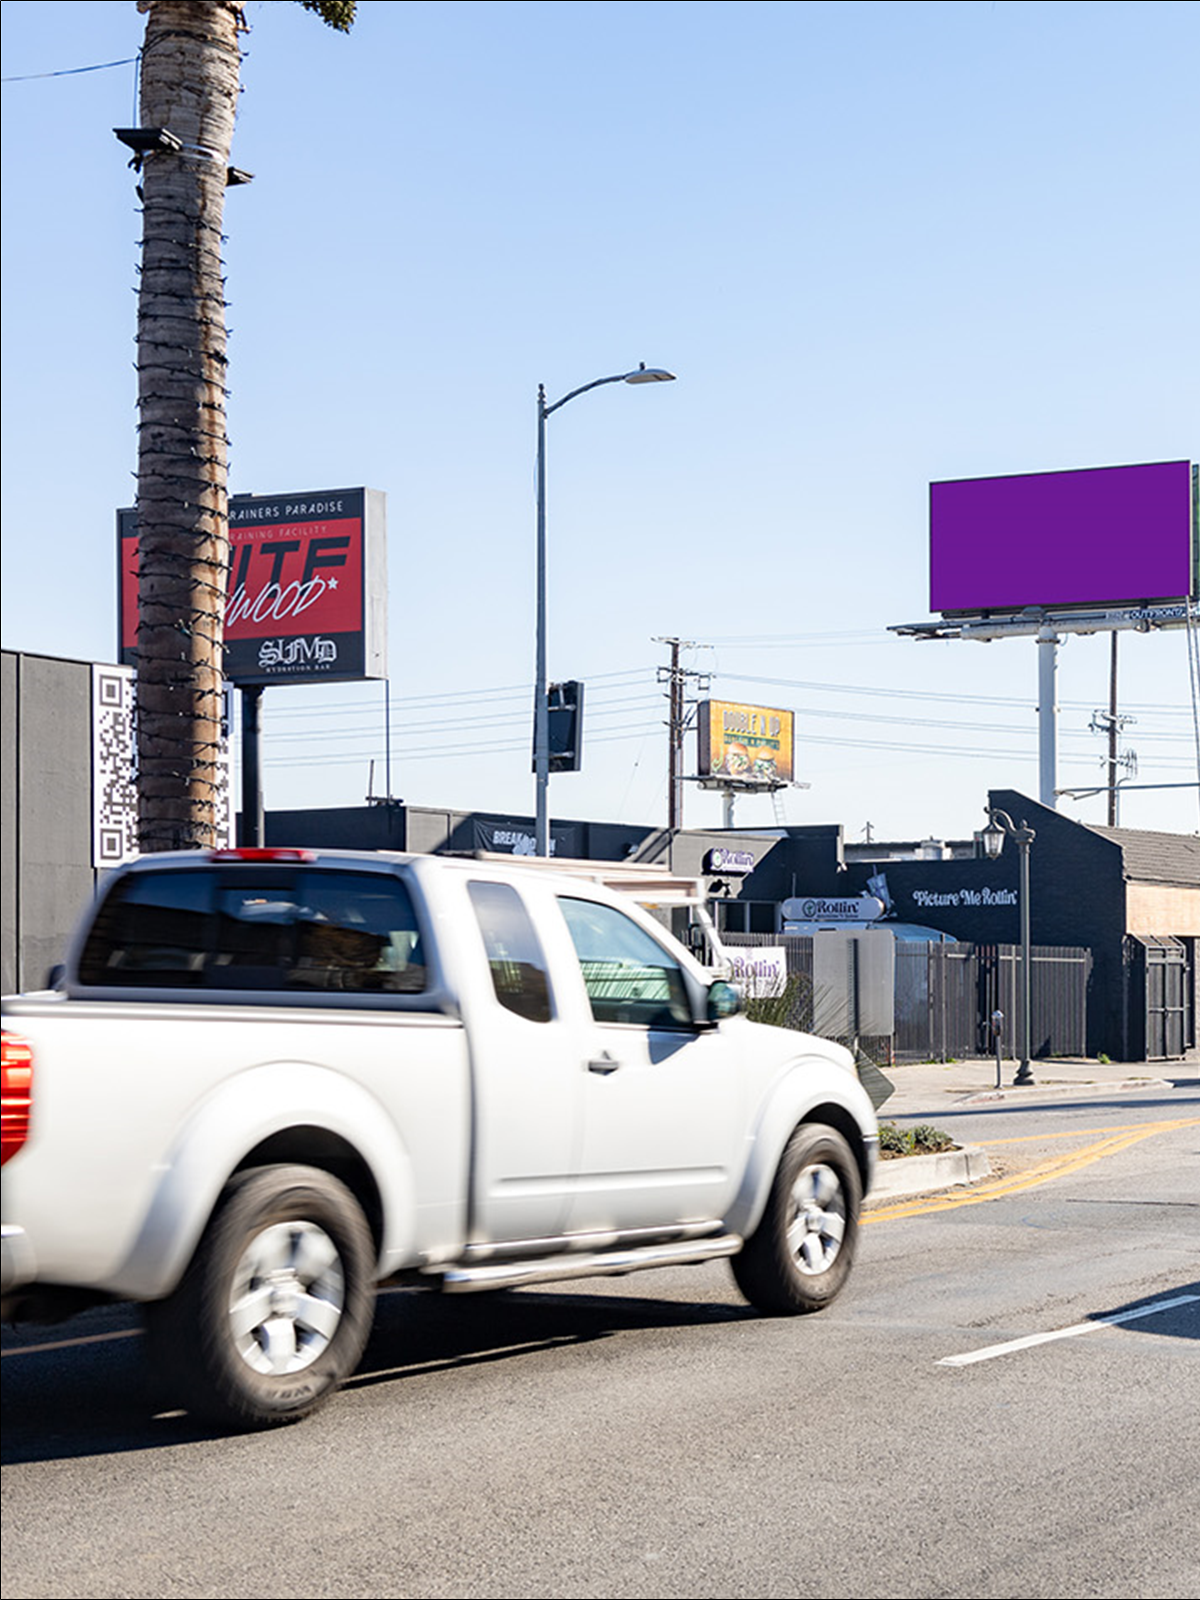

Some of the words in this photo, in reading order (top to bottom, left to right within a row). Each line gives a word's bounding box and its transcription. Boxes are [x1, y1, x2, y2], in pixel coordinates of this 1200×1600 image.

[229, 506, 280, 521] RAINERS
[285, 500, 343, 516] PARADISE
[230, 529, 273, 541] RAINING
[279, 525, 328, 537] FACILITY
[912, 889, 960, 907] Picture
[959, 888, 981, 906] Me
